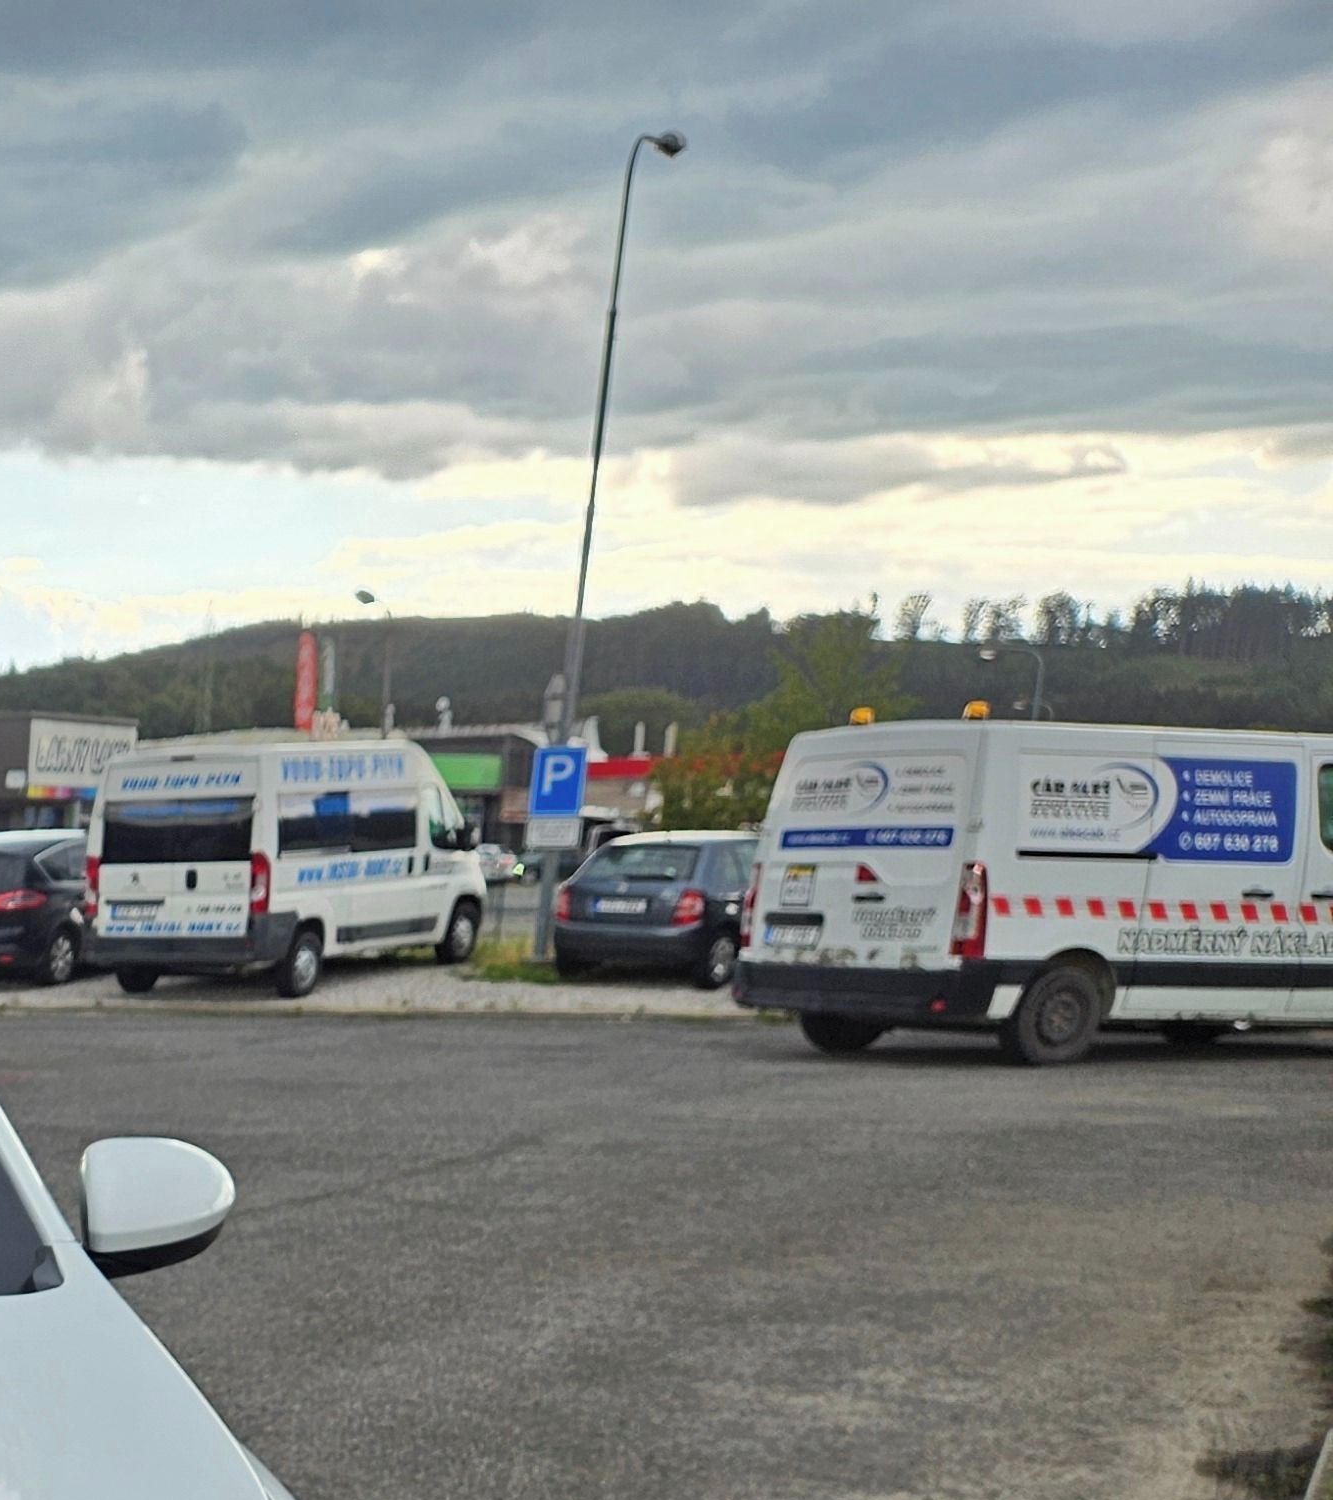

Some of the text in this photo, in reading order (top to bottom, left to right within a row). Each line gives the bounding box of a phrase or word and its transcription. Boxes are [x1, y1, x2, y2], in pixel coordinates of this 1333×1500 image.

[541, 754, 575, 795] P
[1194, 769, 1253, 787] DEMOLICE
[1232, 788, 1272, 807] PRÁCE
[1193, 810, 1278, 827] AUTODOPRAVA
